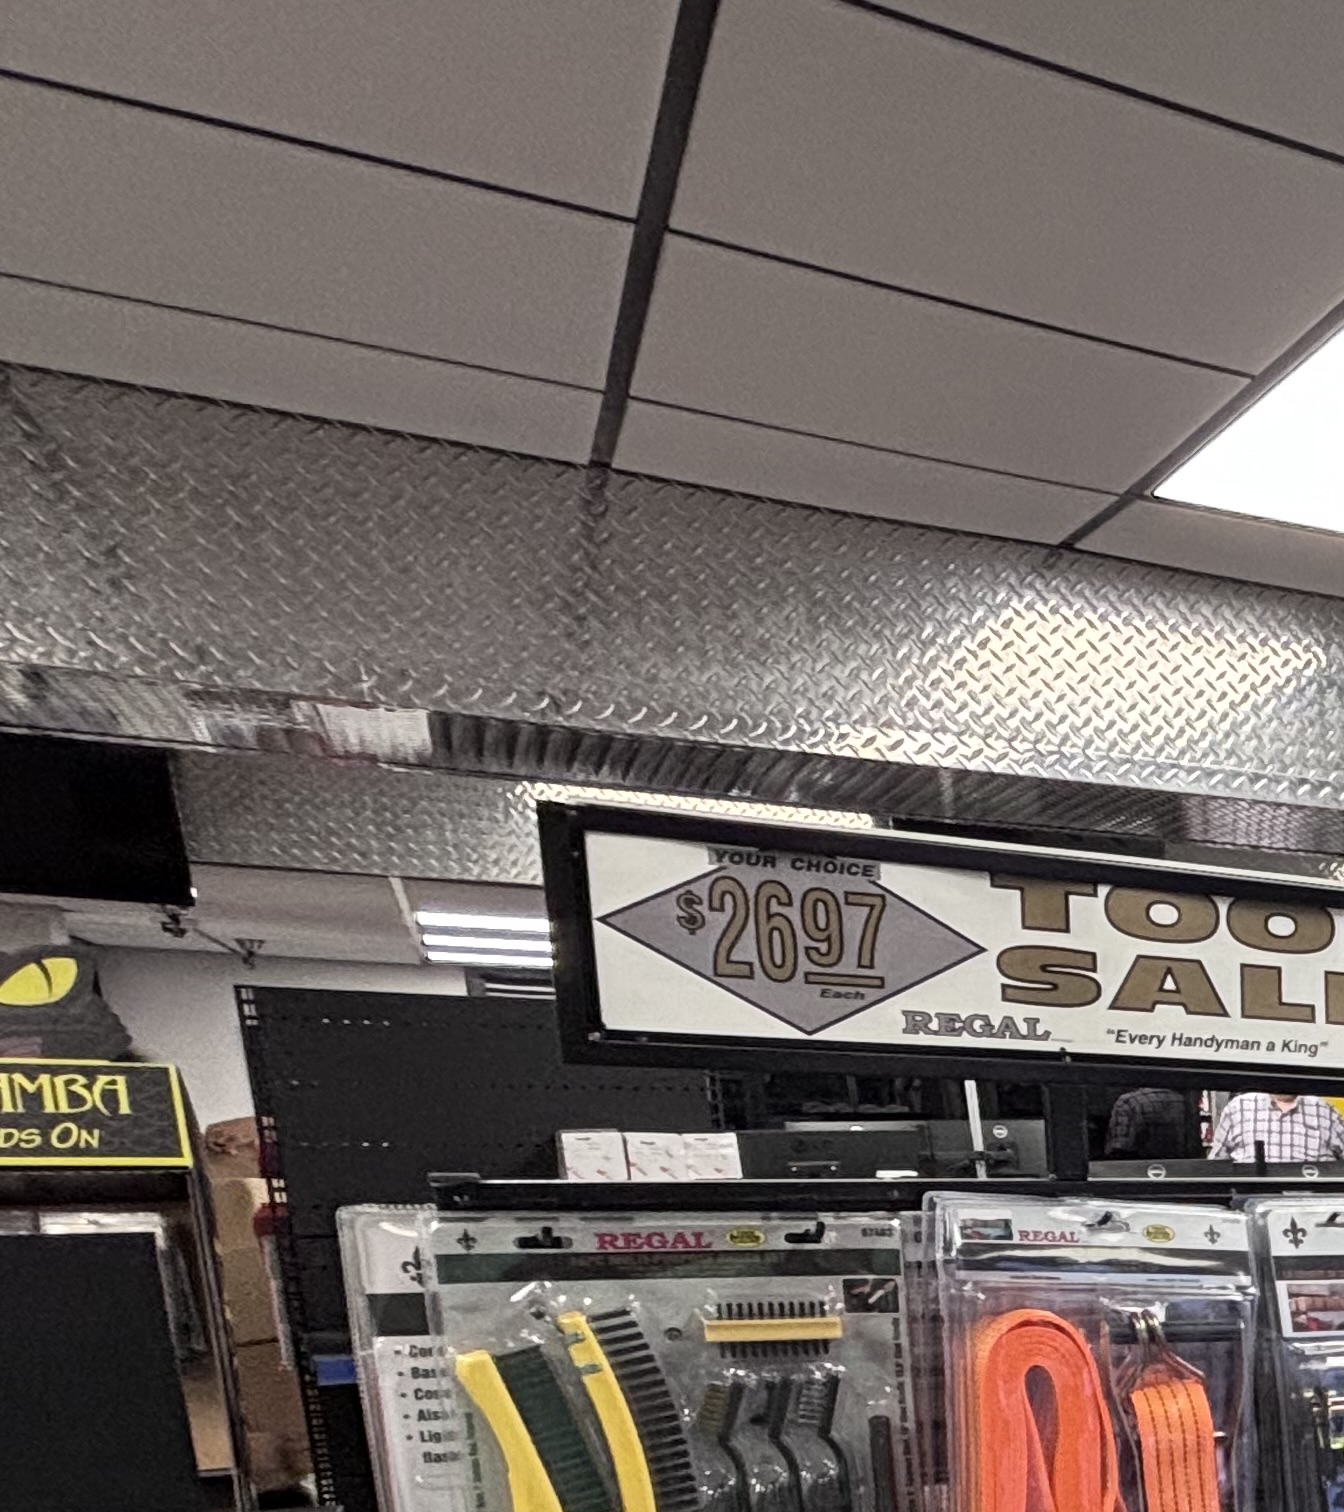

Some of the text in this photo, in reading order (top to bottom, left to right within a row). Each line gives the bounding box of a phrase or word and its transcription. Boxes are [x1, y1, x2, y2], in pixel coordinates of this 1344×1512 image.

[715, 850, 876, 877] YOUR CHOICE
[820, 988, 865, 1000] Each
[902, 1010, 1051, 1041] REGAL
[1170, 1032, 1262, 1054] Handyman
[1266, 1041, 1277, 1053] a
[594, 1231, 713, 1251] REGAL
[1018, 1229, 1080, 1244] REGAL
